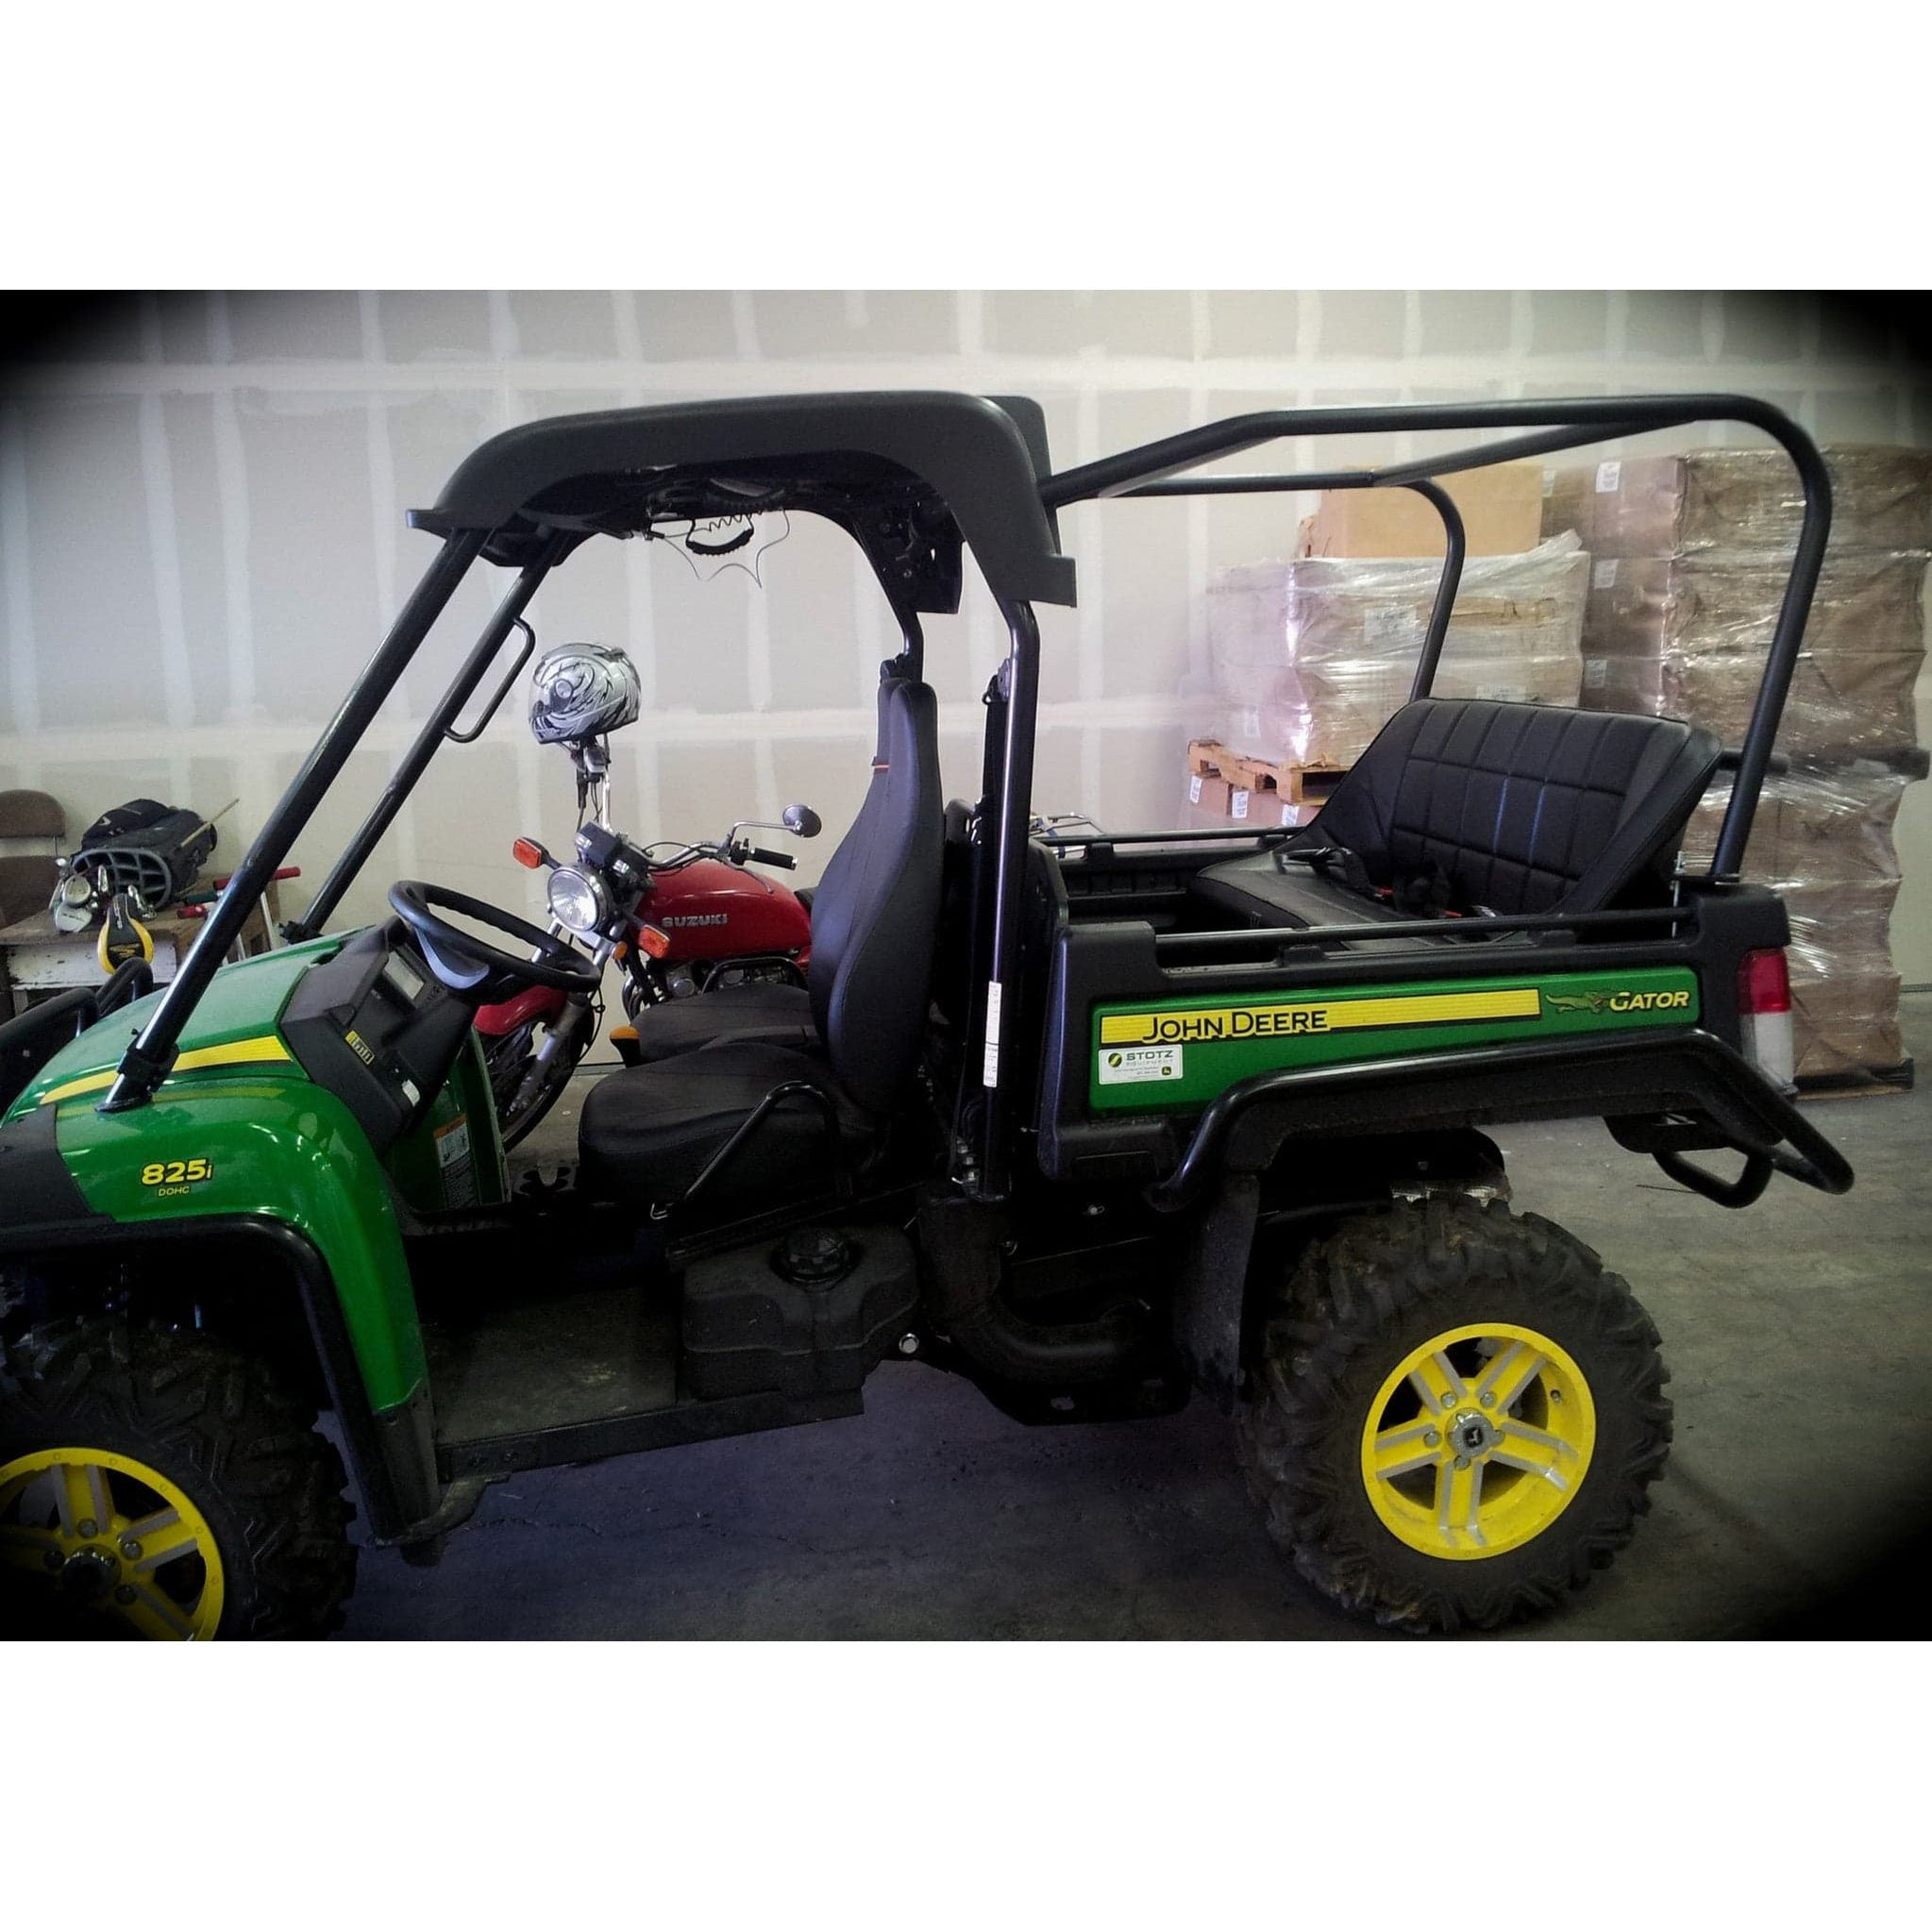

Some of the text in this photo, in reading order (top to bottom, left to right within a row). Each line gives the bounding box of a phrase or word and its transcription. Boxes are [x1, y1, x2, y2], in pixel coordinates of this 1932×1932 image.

[663, 914, 728, 927] SUZUKI
[1610, 991, 1689, 1011] GATOR
[1143, 1010, 1327, 1040] JOHN DEERE
[1127, 1050, 1173, 1060] STOTZ
[142, 1159, 212, 1185] 825i
[158, 1186, 190, 1197] DOHC
